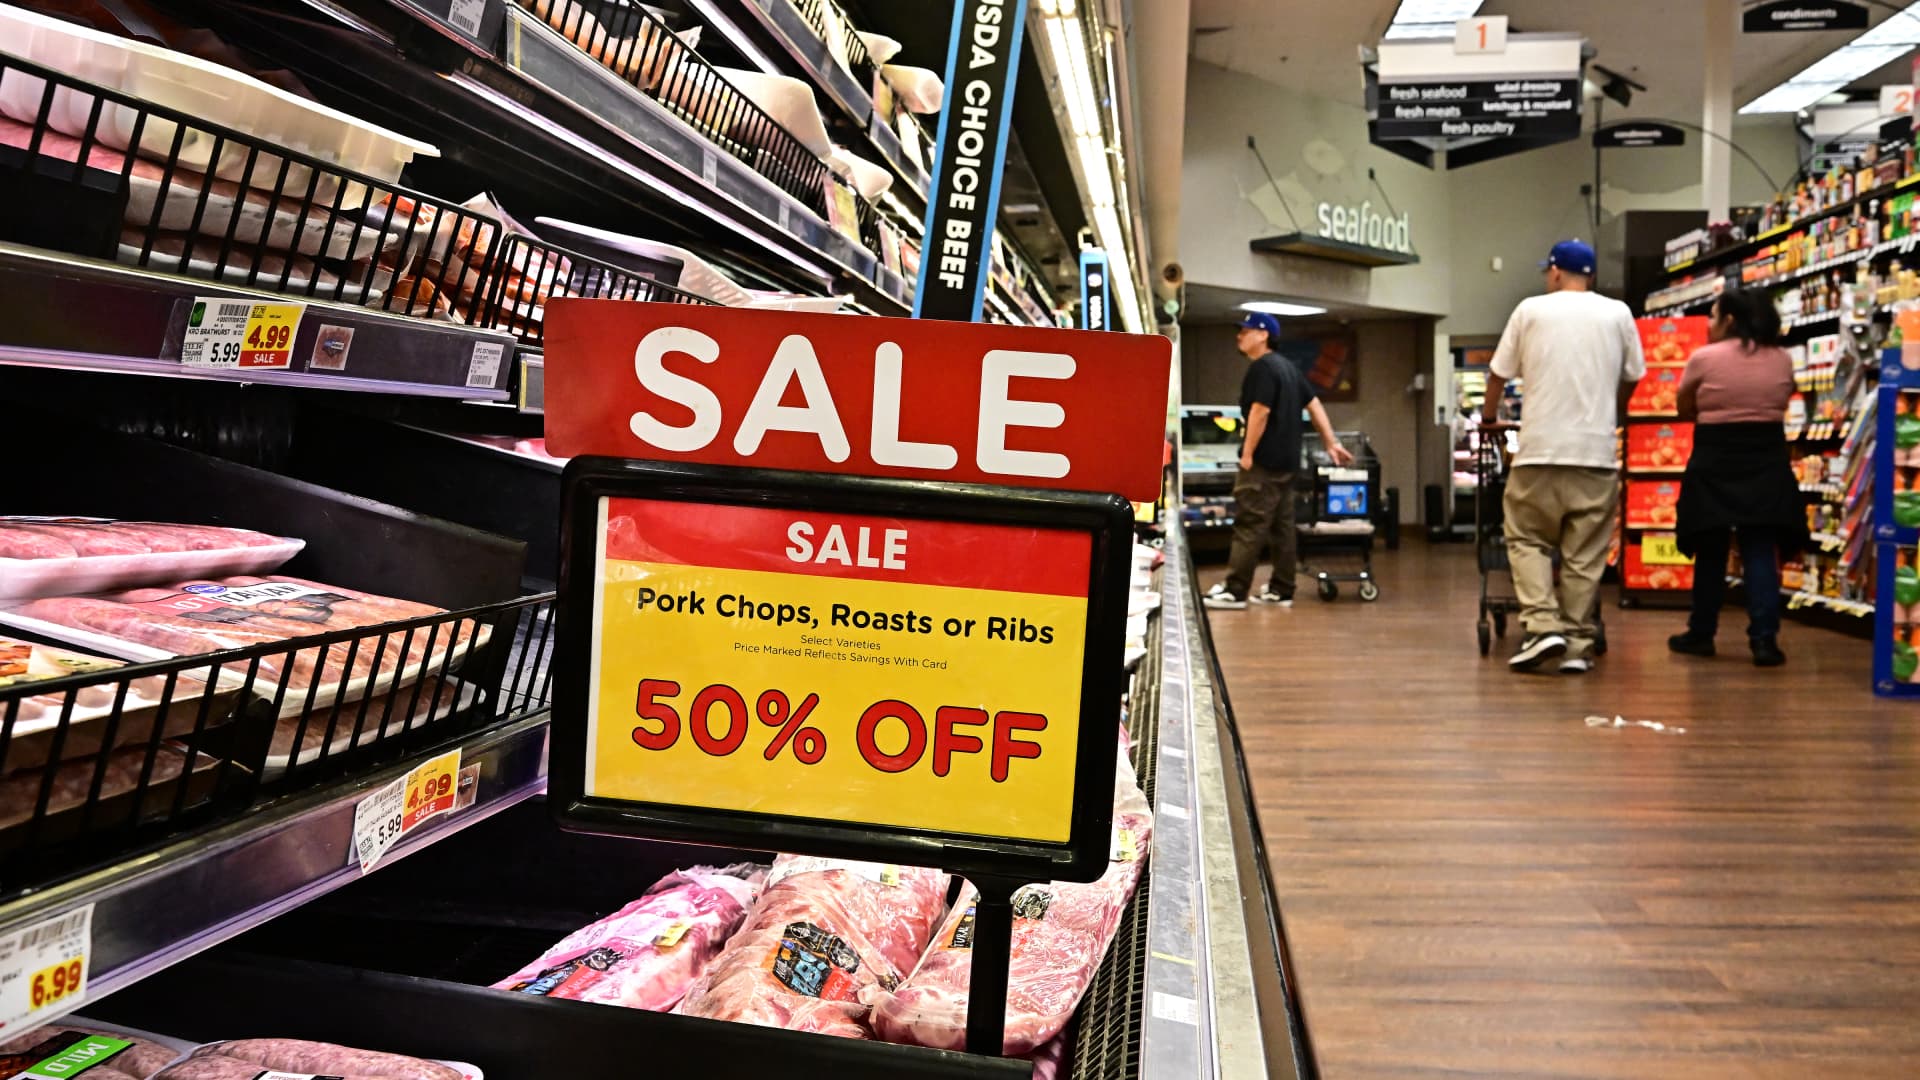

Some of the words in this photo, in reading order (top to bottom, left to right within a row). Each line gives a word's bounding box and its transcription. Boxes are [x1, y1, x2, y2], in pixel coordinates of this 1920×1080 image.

[969, 0, 1004, 69] SDA
[1476, 23, 1488, 49] 1
[1390, 86, 1419, 99] fresh
[1421, 85, 1467, 99] seafood
[1483, 101, 1521, 113] ketchup
[1532, 99, 1572, 110] mustard
[1894, 90, 1912, 113] 2
[1395, 105, 1424, 118] fresh
[1425, 106, 1461, 118] meats
[1441, 121, 1470, 134] fresh
[1472, 121, 1515, 135] poultry
[949, 80, 992, 211] CHOICE
[1318, 199, 1409, 254] seafood
[939, 218, 972, 290] BEEF
[247, 324, 290, 349] 4.99
[210, 342, 240, 363] 5.99
[253, 353, 276, 364] SALE
[630, 326, 1077, 479] SALE
[786, 521, 909, 570] SALE
[637, 587, 705, 615] Pork
[716, 594, 819, 629] Chops,
[831, 603, 933, 634] Roasts
[943, 617, 976, 638] or
[987, 616, 1054, 645] Ribs
[734, 642, 760, 653] Price
[763, 644, 801, 657] Marked
[804, 648, 847, 661] Reflects
[849, 652, 890, 666] Savings
[893, 655, 919, 667] With
[922, 658, 947, 669] Card
[800, 634, 833, 646] Select
[836, 637, 881, 650] Varieties
[632, 678, 827, 765] 50%
[856, 699, 1048, 783] OFF
[407, 773, 452, 808] 4.99
[415, 801, 436, 821] SALE
[378, 814, 402, 845] 5.99
[32, 960, 82, 1008] 6.99
[44, 1041, 110, 1073] MILD
